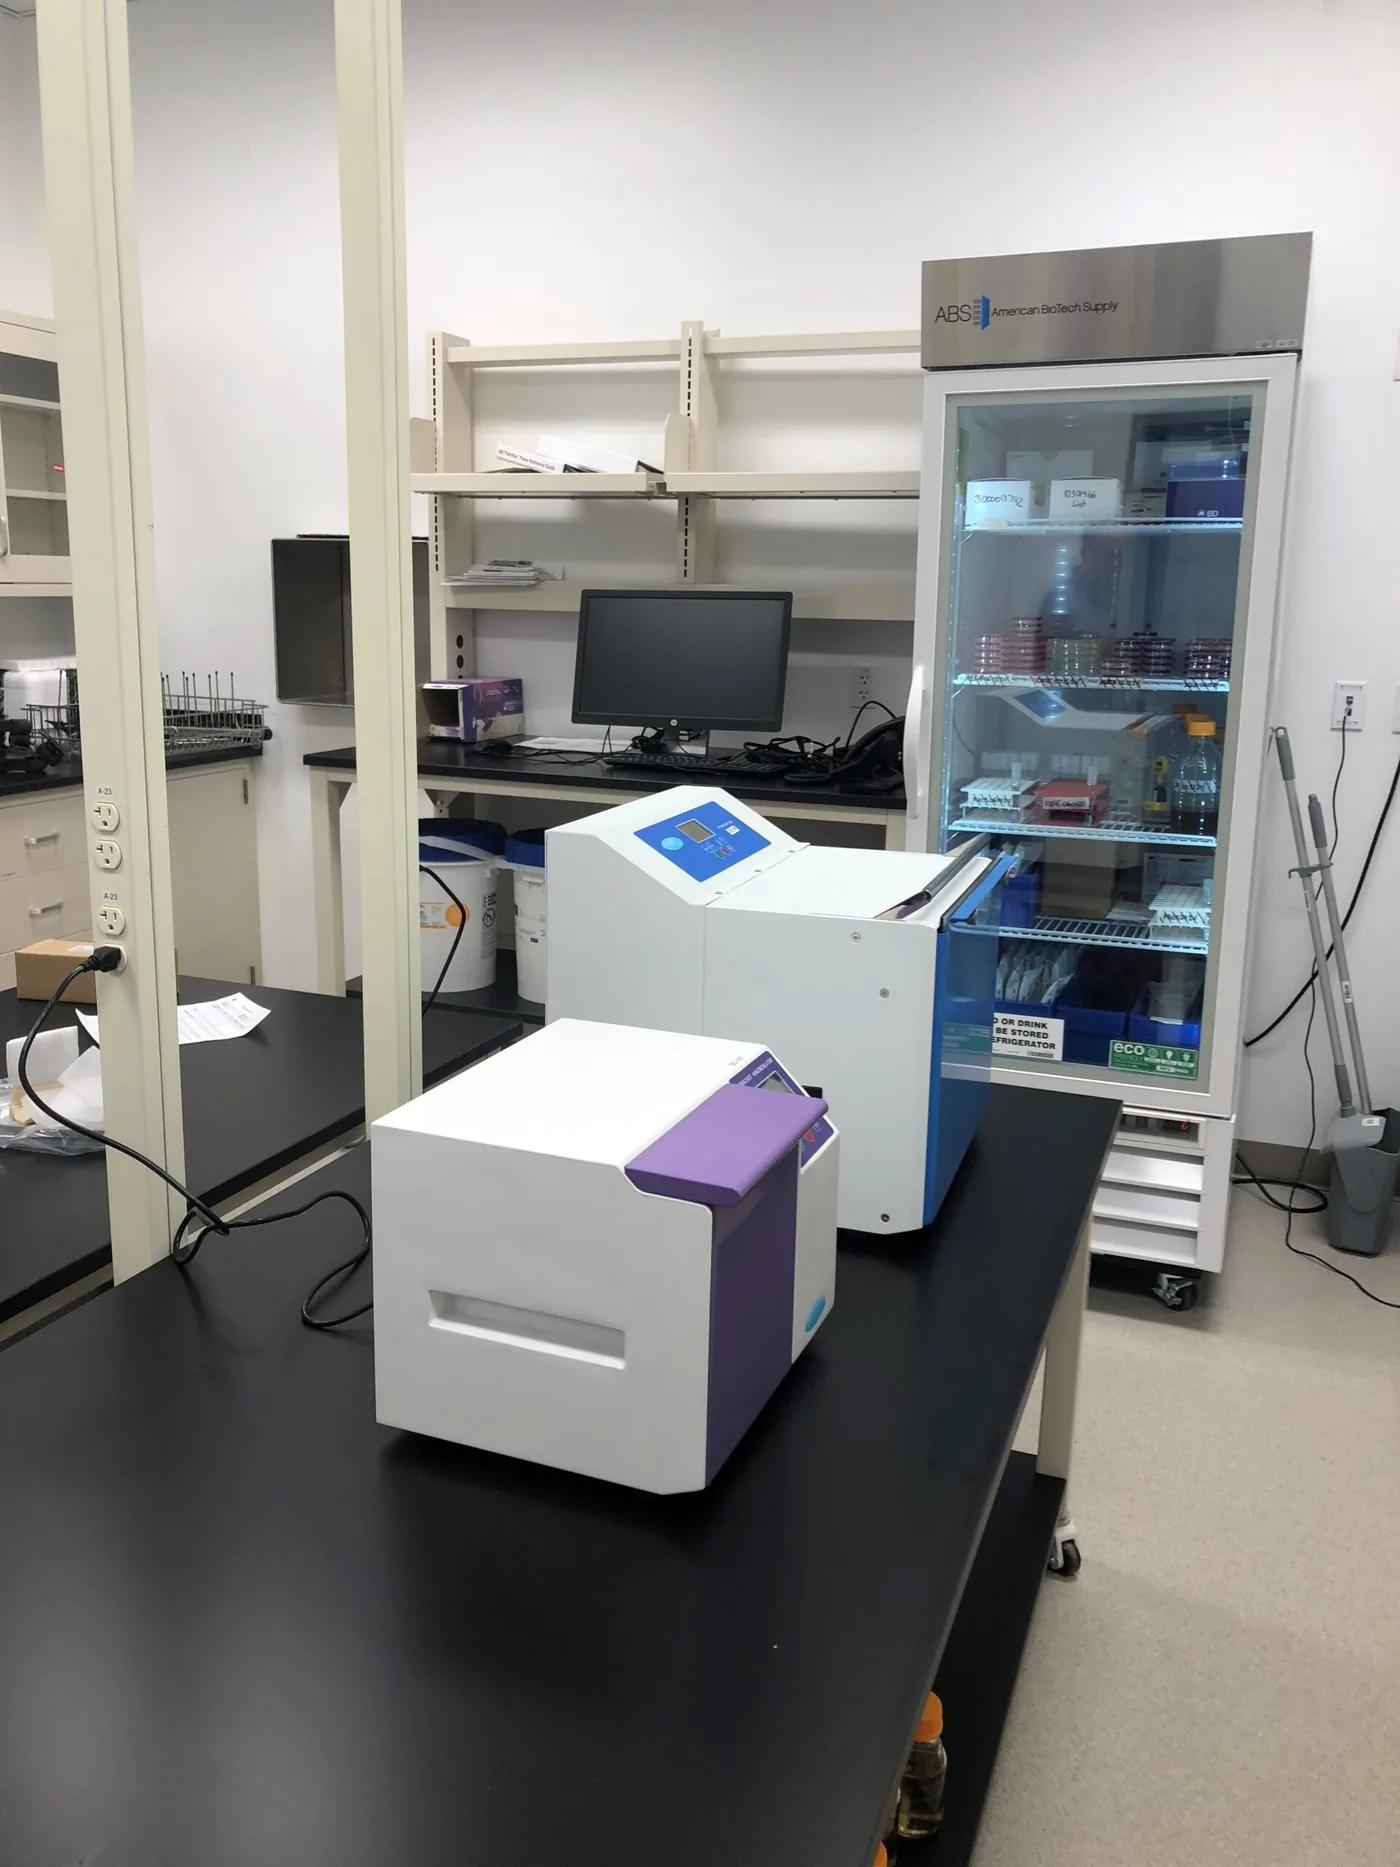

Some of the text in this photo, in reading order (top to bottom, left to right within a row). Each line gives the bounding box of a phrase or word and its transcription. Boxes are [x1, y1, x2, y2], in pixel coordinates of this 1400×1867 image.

[935, 301, 1119, 323] ABS American BioTech Supply
[1001, 1018, 1015, 1026] OR
[1018, 1020, 1048, 1029] DRINK
[1010, 1028, 1049, 1039] STORED
[992, 1036, 1056, 1050] EFRIGERATOR
[1113, 1042, 1145, 1056] eco
